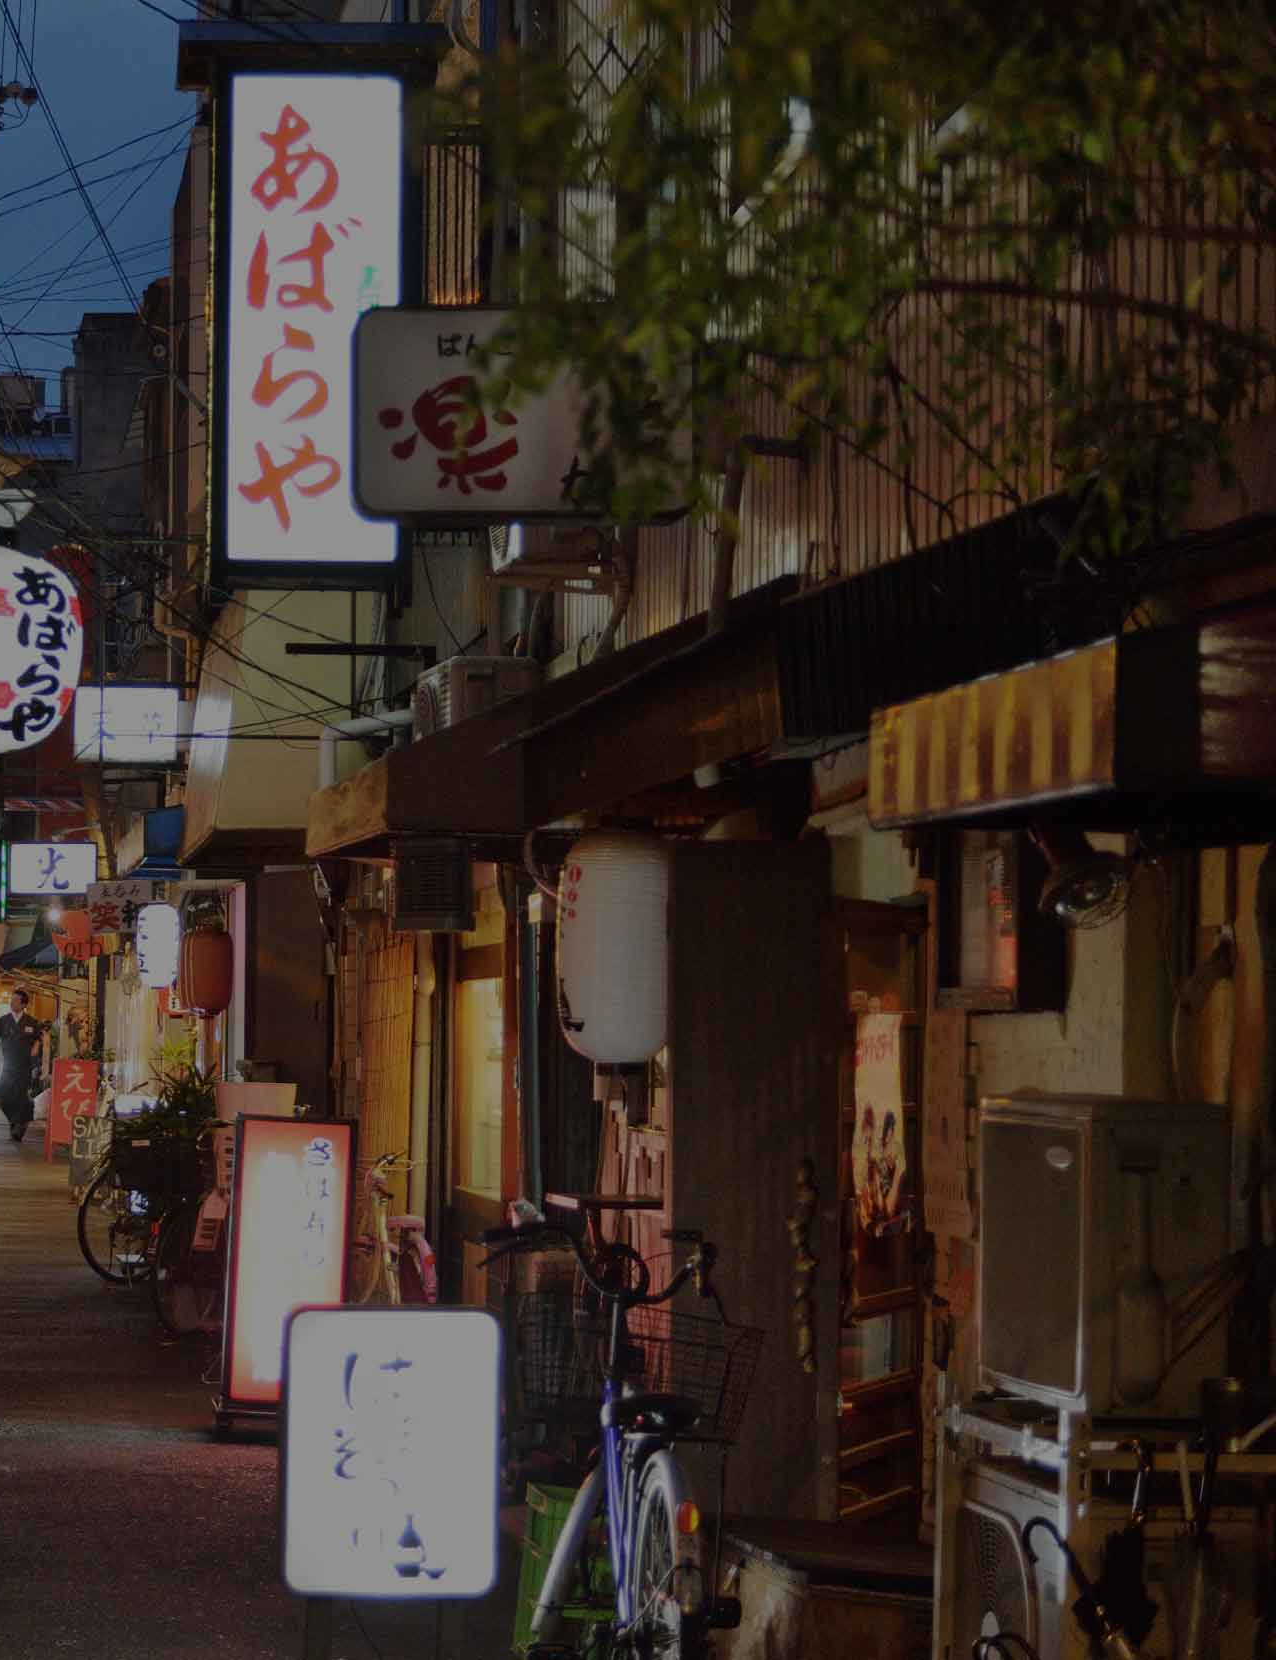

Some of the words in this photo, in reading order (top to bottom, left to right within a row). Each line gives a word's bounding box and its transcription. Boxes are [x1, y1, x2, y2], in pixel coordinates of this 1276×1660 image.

[237, 103, 362, 534] あばらや
[37, 847, 69, 889] 光
